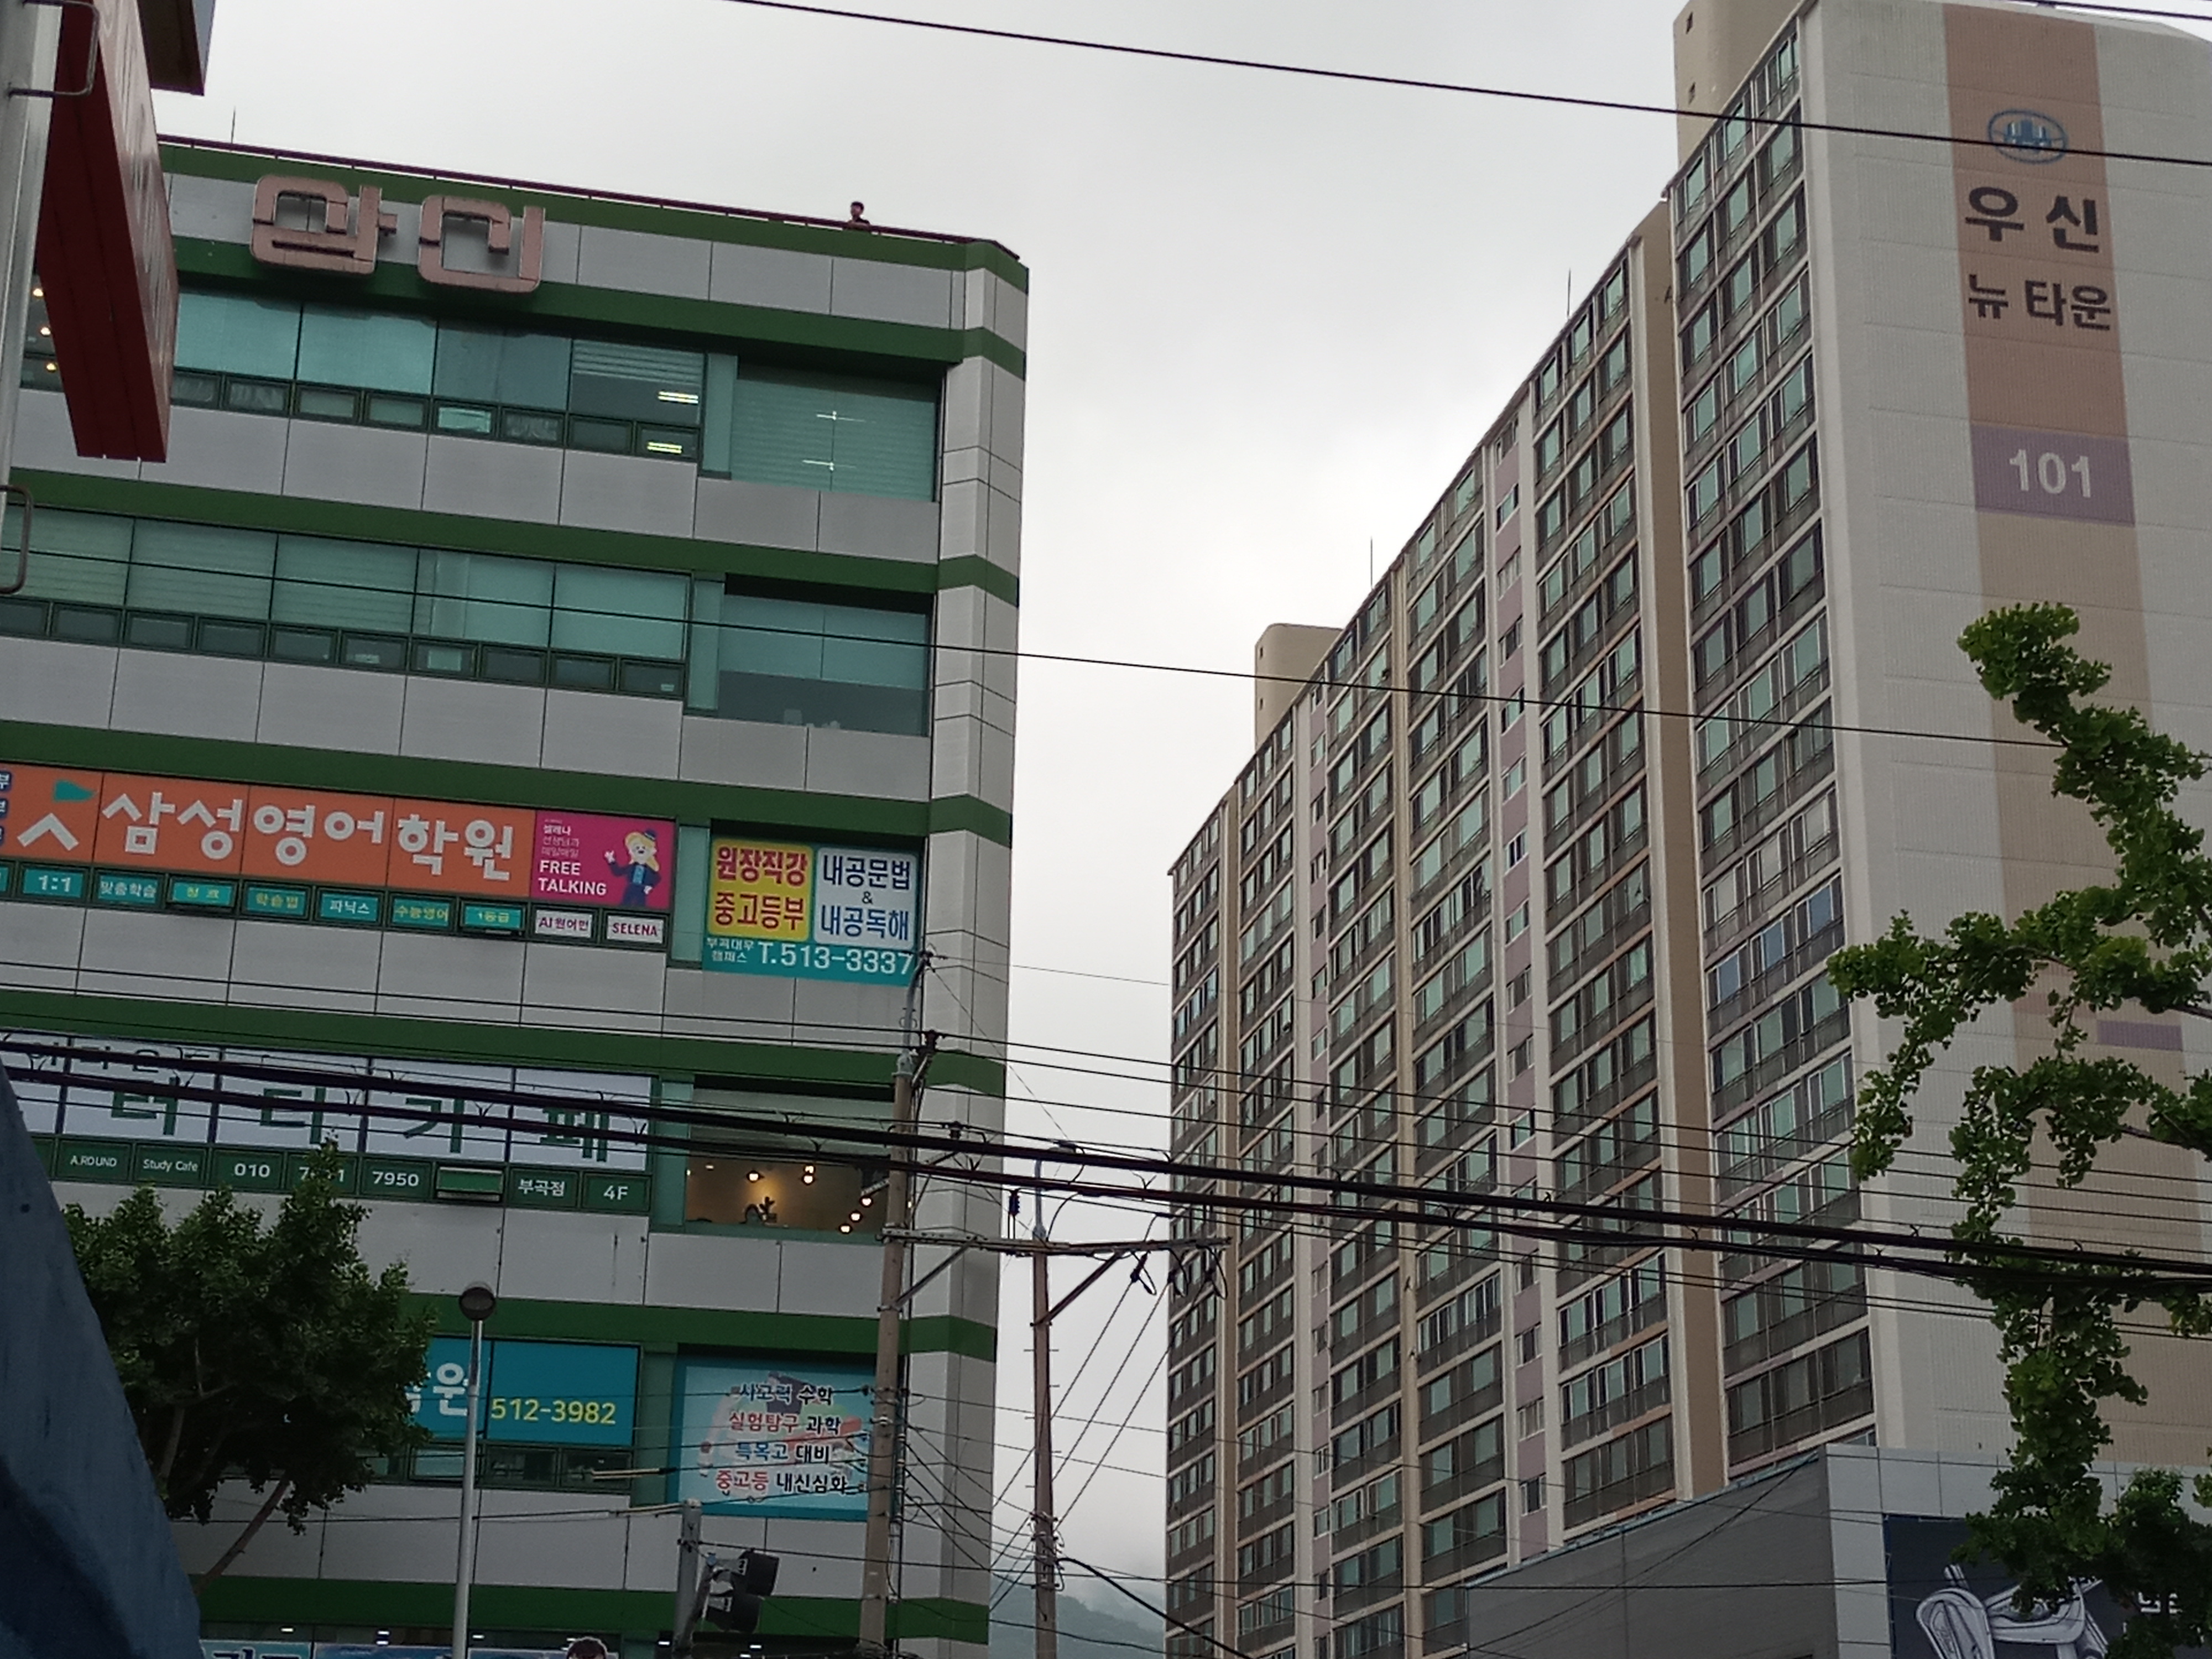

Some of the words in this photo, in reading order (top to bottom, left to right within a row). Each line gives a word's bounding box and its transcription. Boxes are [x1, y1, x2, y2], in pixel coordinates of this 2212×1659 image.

[2008, 449, 2091, 498] 101
[102, 791, 514, 881] 삼성영어학원
[540, 860, 581, 875] FREE
[717, 846, 808, 886] 원장직강
[823, 854, 910, 890] 내공문법
[538, 878, 607, 896] TALKING
[330, 900, 370, 914] 파닉스
[862, 891, 874, 905] &
[395, 905, 448, 922] 수능영어
[715, 891, 804, 931] 중고등부
[612, 922, 658, 937] SELENA
[821, 904, 909, 941] 내공독해
[707, 937, 754, 951] 부곡대우
[712, 950, 747, 963] 캠퍼스
[758, 941, 914, 975] T.513-3337
[143, 1159, 172, 1172] Study
[175, 1161, 199, 1171] Cafe
[234, 1164, 270, 1178] 010
[372, 1171, 419, 1187] 7950
[518, 1178, 565, 1196] 부곡점
[603, 1186, 628, 1199] 4F
[740, 1383, 792, 1404] 사고력
[799, 1385, 832, 1405] 수학
[491, 1398, 616, 1425] 512-3982
[729, 1412, 799, 1433] 실험탐구
[806, 1416, 841, 1435] 과학
[735, 1442, 788, 1461] 특목고
[796, 1444, 829, 1464] 대비
[717, 1470, 769, 1491] 중고등
[777, 1473, 847, 1495] 내신심화
